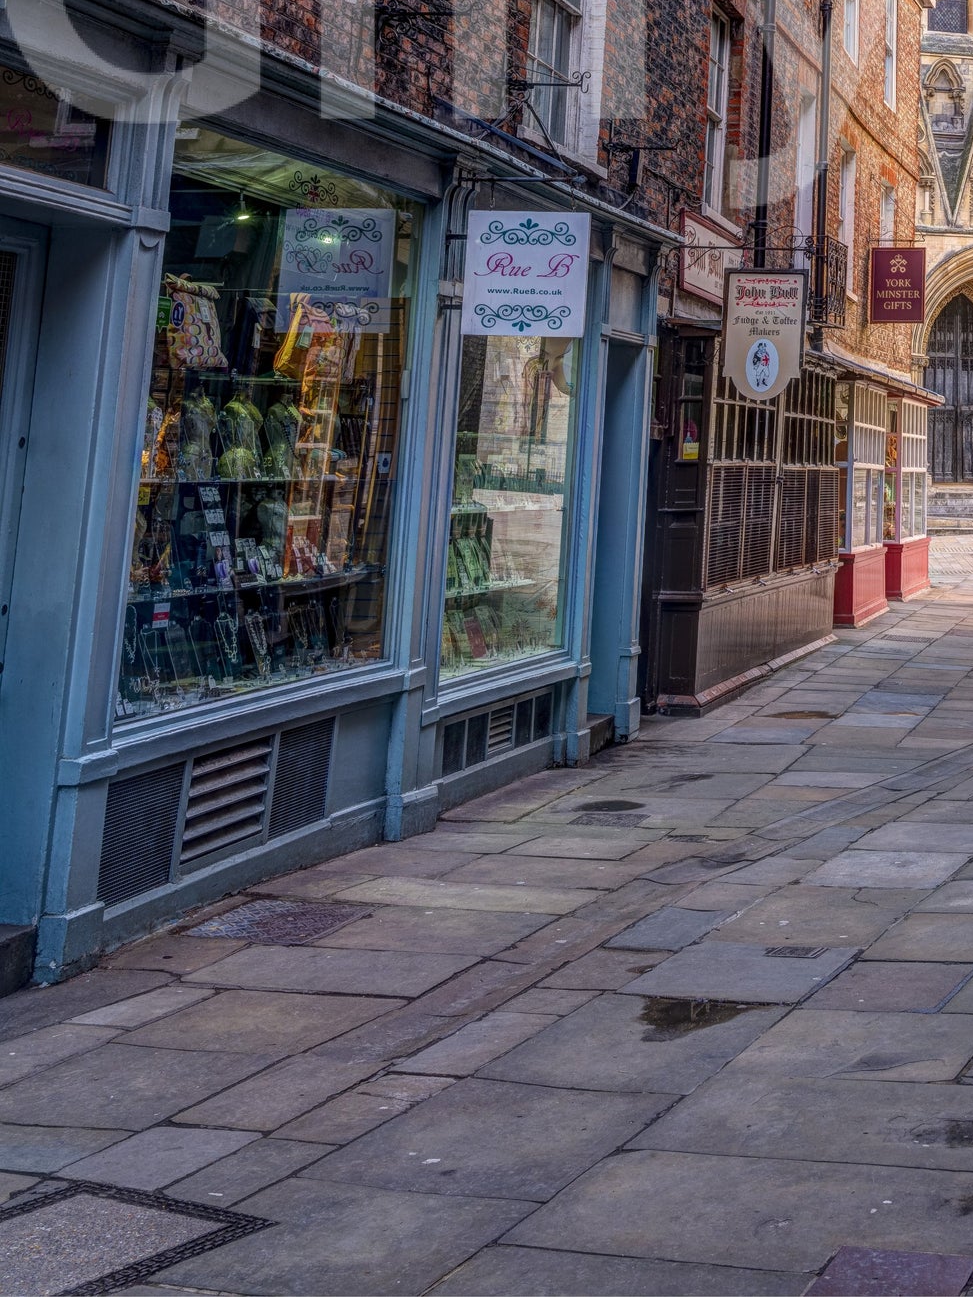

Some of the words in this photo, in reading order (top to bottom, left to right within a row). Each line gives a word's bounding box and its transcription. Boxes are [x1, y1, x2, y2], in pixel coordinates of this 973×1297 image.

[473, 251, 532, 277] Rue
[536, 253, 580, 278] B
[885, 278, 912, 288] YORK
[487, 287, 563, 296] www.RueB.co.uk
[735, 285, 767, 301] John
[770, 285, 798, 301] Bull
[876, 290, 921, 300] MINSTER
[883, 301, 912, 310] GIFTS
[732, 315, 760, 326] Fudge
[762, 315, 770, 325] &
[773, 315, 798, 326] Toffee
[748, 326, 781, 337] Makers
